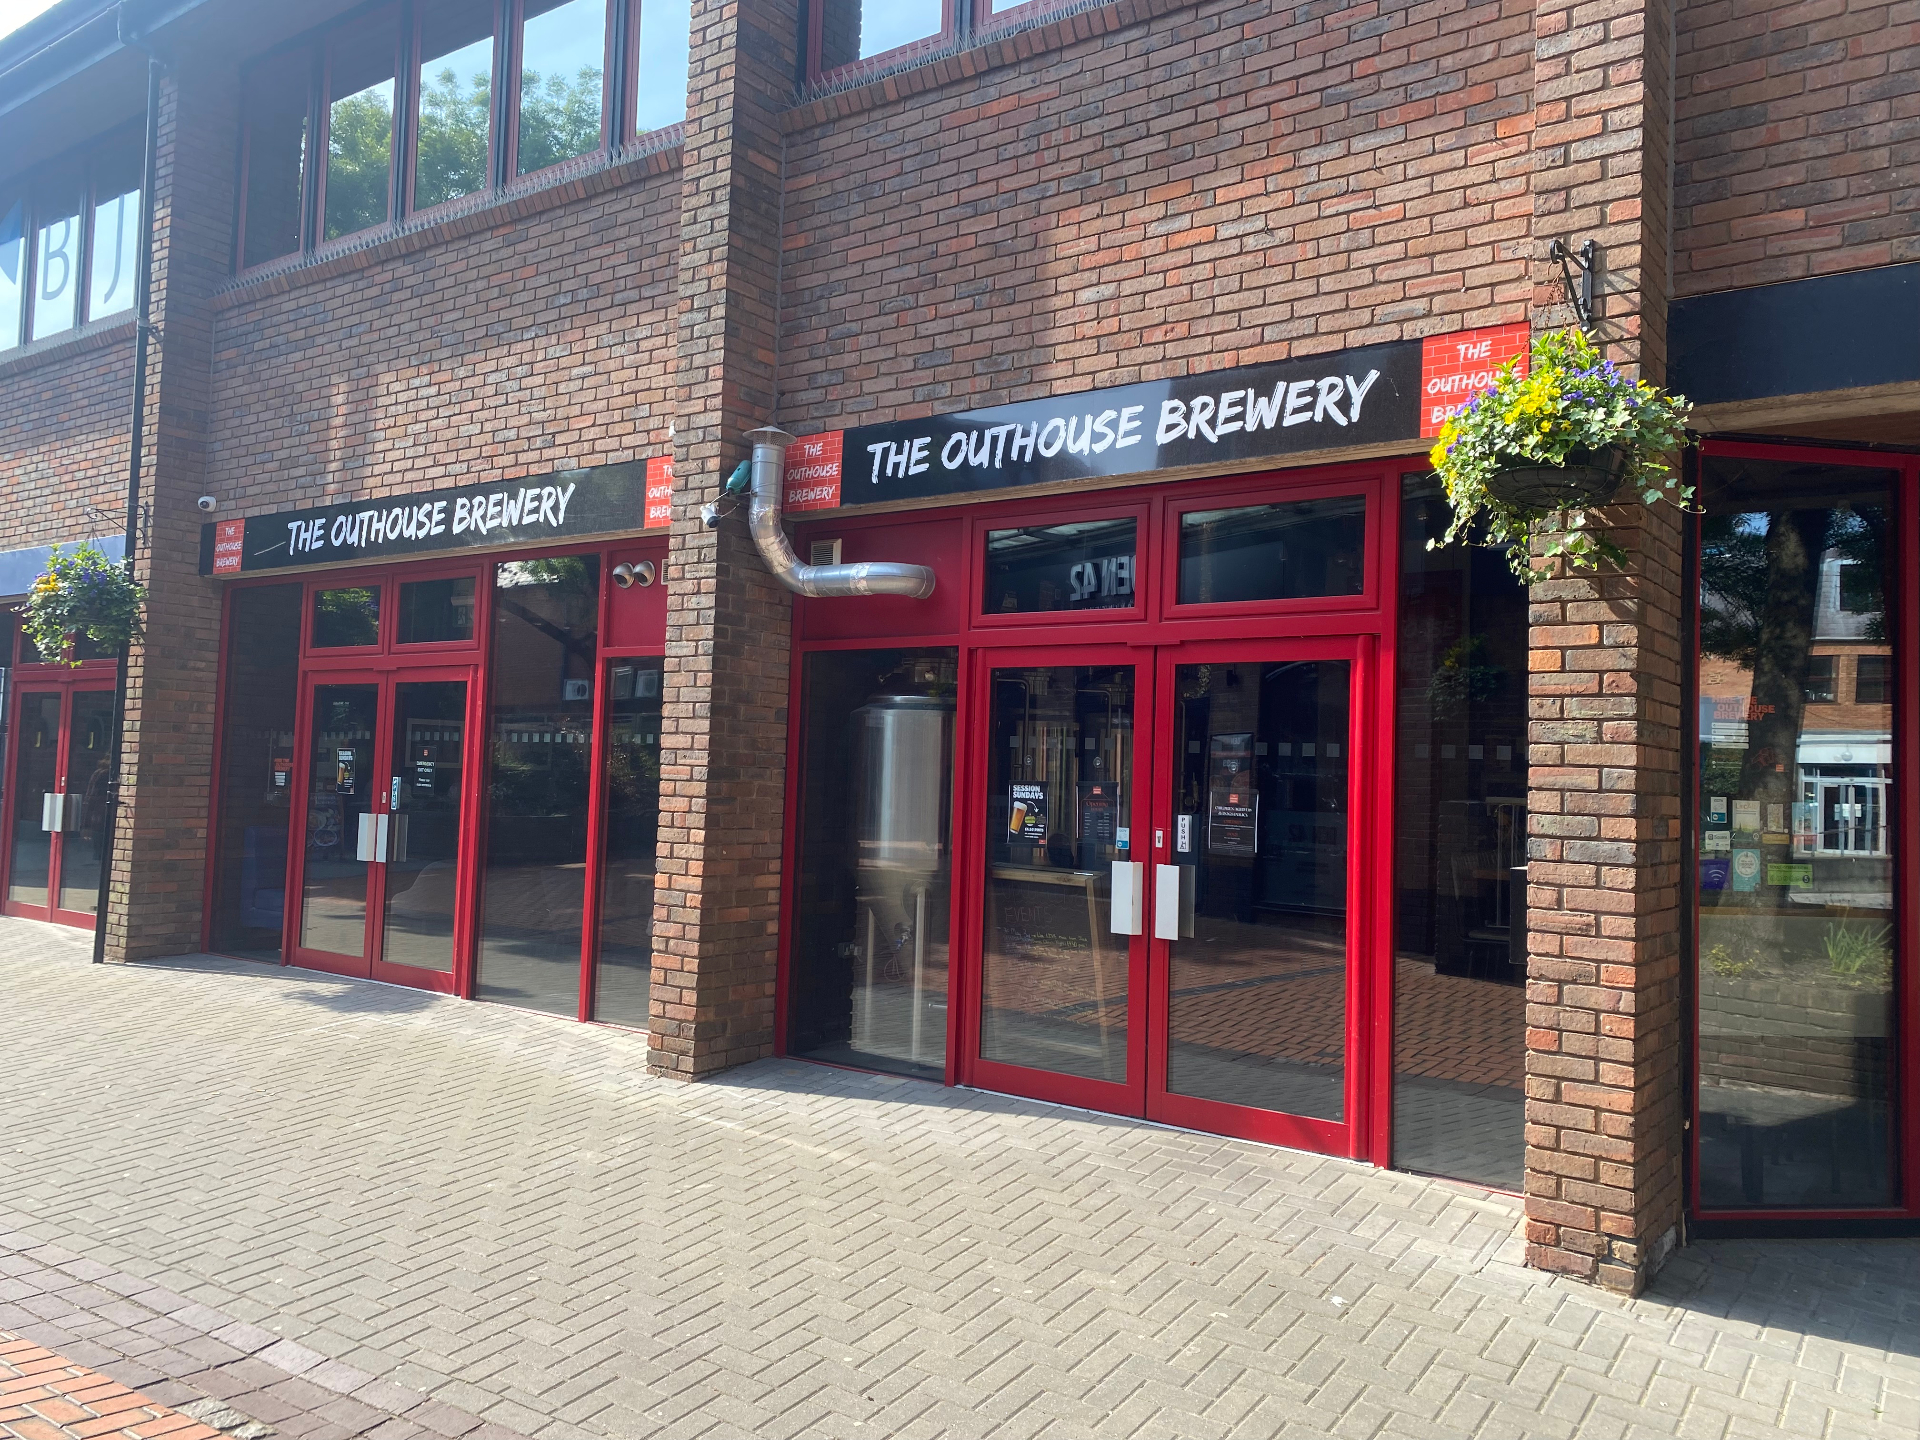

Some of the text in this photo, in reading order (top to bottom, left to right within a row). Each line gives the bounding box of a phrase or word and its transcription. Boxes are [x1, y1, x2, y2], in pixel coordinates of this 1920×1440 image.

[1457, 341, 1492, 361] THE
[1427, 367, 1523, 394] OUTHOUE
[867, 369, 1381, 484] THE OUTHOUSE BREWERY
[804, 443, 823, 457] THE
[663, 465, 673, 477] TH
[788, 463, 839, 480] OUTHOUSE
[649, 485, 673, 498] OUTH
[789, 486, 836, 502] BREWERY
[288, 482, 576, 555] THE OUTHOUSE BREWERY
[225, 527, 235, 537] THE
[216, 541, 242, 552] OUTHOUSE
[216, 556, 240, 567] BREWERY
[1717, 704, 1775, 713] OUTHOUSE
[1714, 711, 1764, 720] BREWERY
[1013, 791, 1043, 799] SUNDAYS
[1004, 905, 1053, 923] EVENTS
